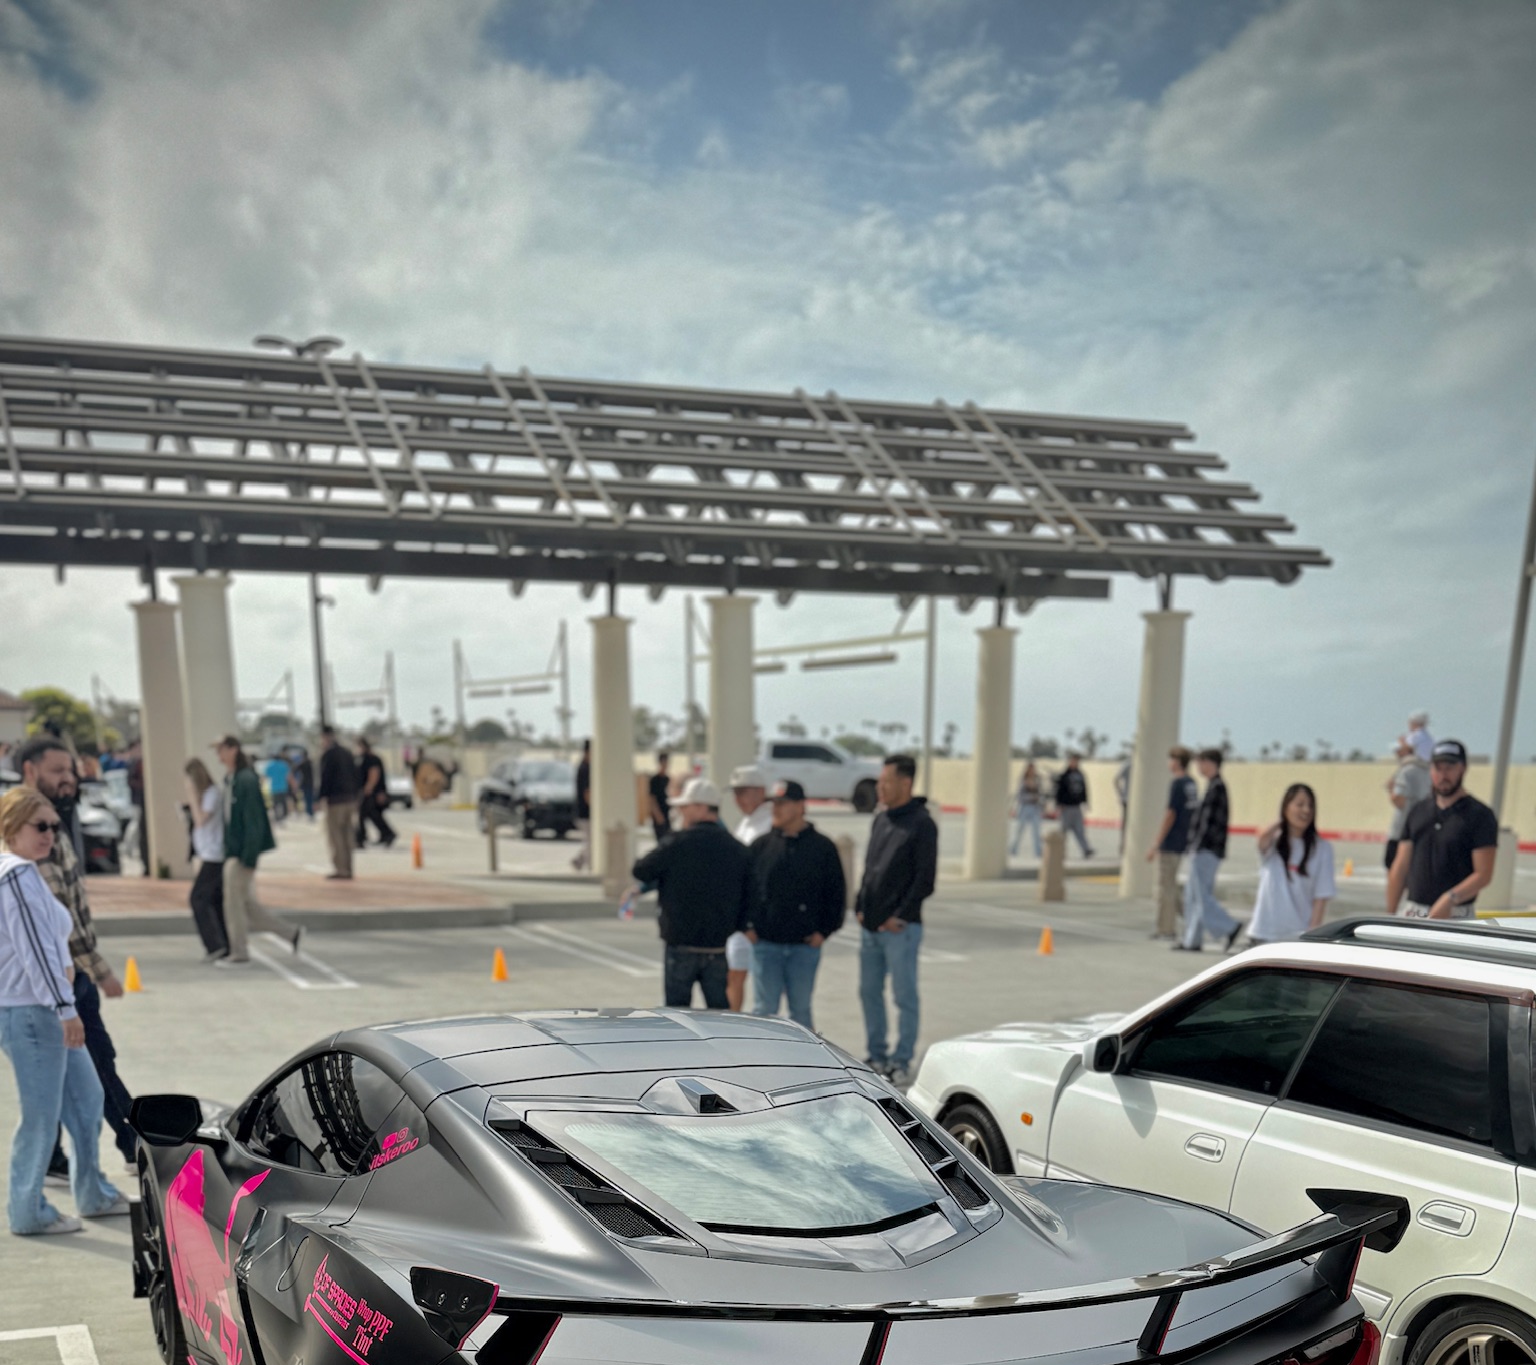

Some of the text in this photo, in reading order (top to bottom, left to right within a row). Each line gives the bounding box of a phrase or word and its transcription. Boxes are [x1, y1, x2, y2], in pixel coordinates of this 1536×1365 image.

[327, 1281, 358, 1320] SPADES
[352, 1325, 373, 1356] Tint
[368, 1310, 394, 1342] PPF
